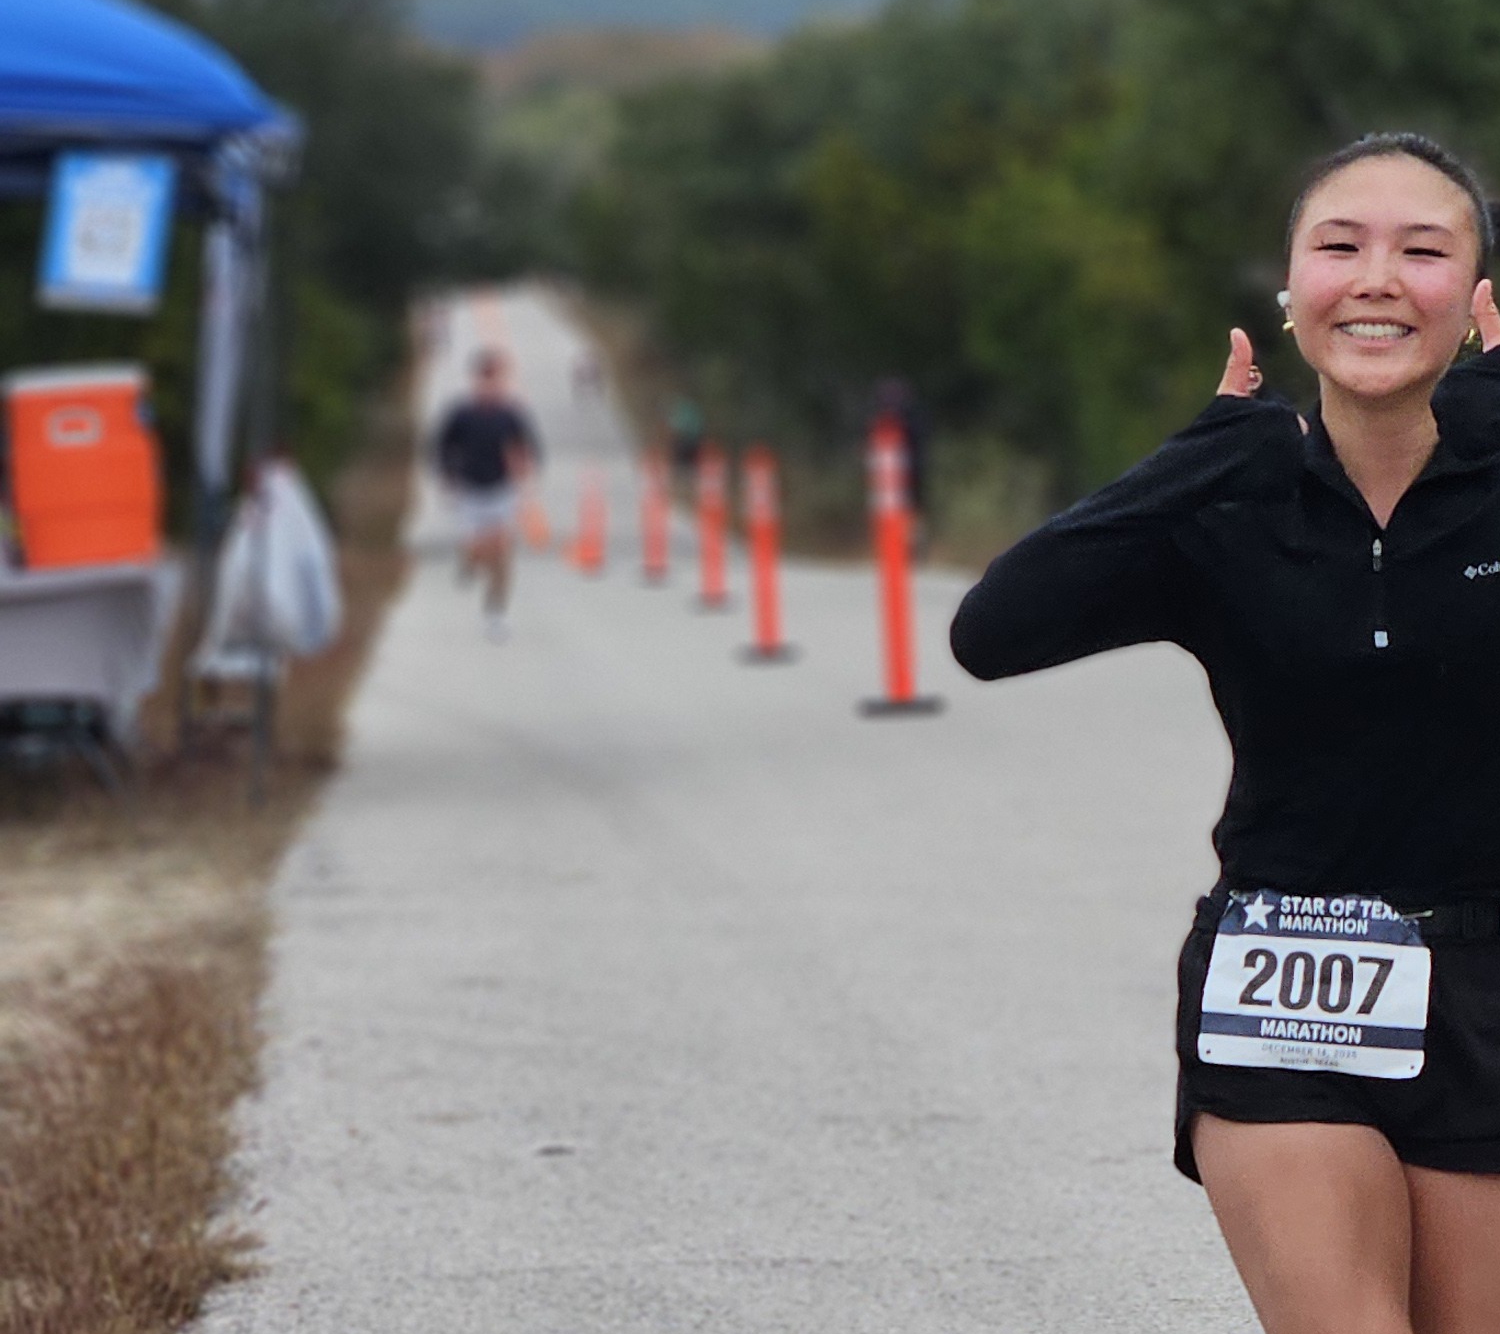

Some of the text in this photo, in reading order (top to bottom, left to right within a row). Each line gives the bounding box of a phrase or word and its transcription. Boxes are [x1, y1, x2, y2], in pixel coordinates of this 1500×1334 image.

[1280, 895, 1325, 916] STAR
[1329, 898, 1357, 917] OF
[1279, 915, 1368, 935] MARATHON
[1238, 948, 1394, 1015] 2007
[1260, 1019, 1362, 1045] MARATHON
